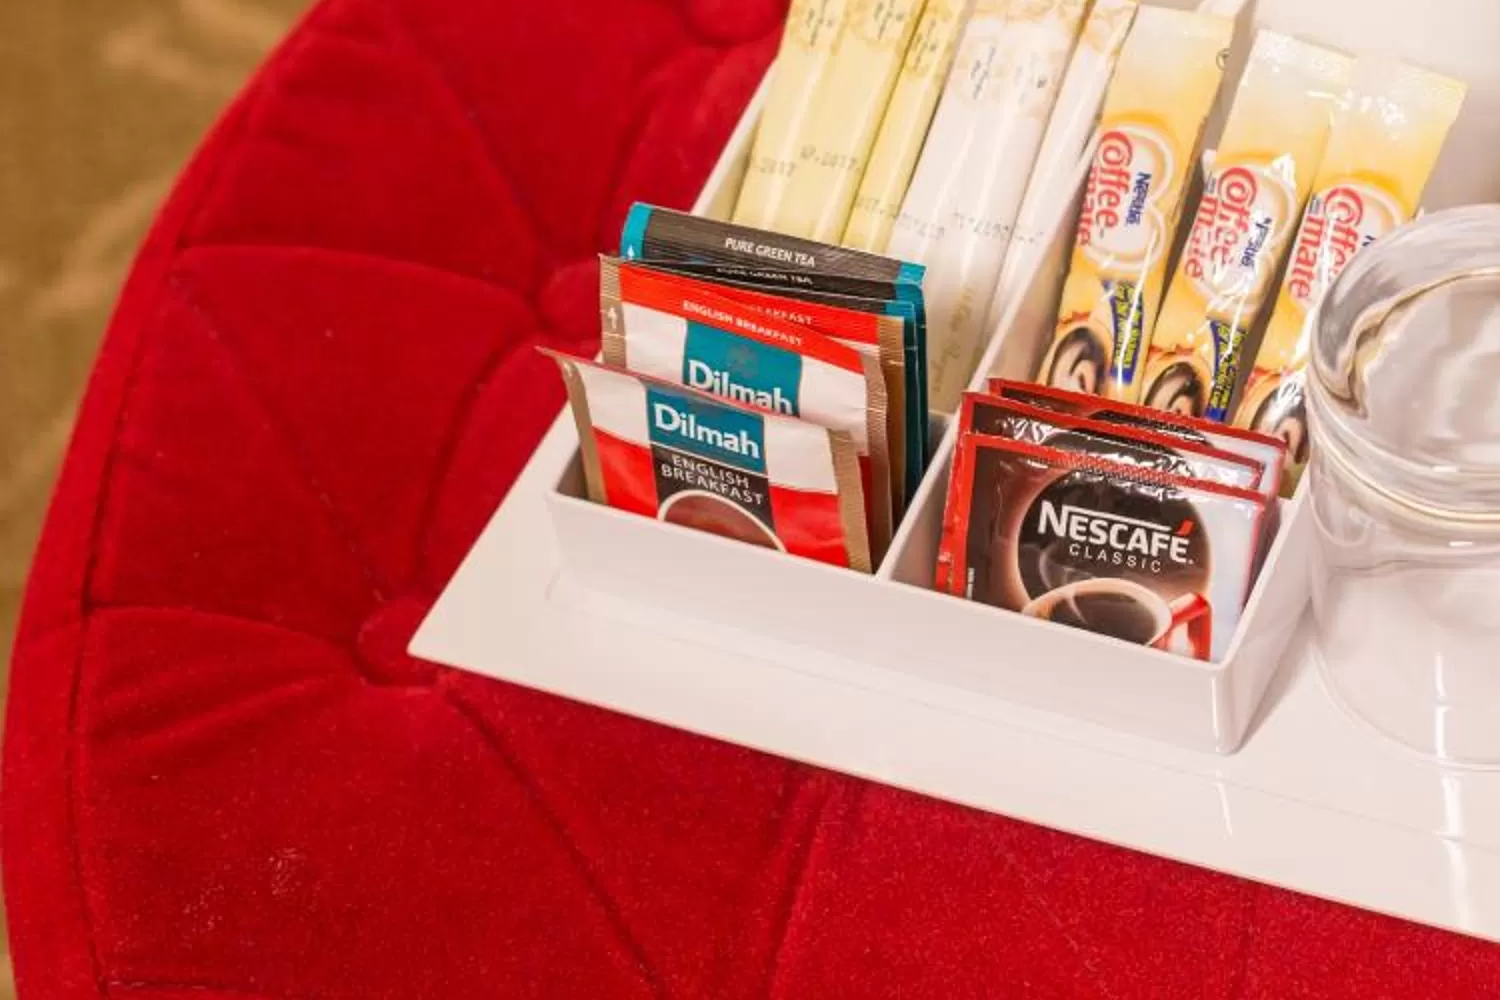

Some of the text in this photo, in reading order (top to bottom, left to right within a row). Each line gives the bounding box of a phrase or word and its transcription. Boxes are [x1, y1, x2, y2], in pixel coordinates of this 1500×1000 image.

[725, 237, 815, 267] PURE GREEN TEA
[683, 299, 802, 346] ENGLISH BREAKFAST
[689, 359, 793, 415] Dilmah
[653, 402, 760, 459] Dilmah
[660, 463, 764, 505] BREAKFAST
[671, 454, 750, 489] ENGLISH
[1068, 542, 1163, 573] CLASSIC
